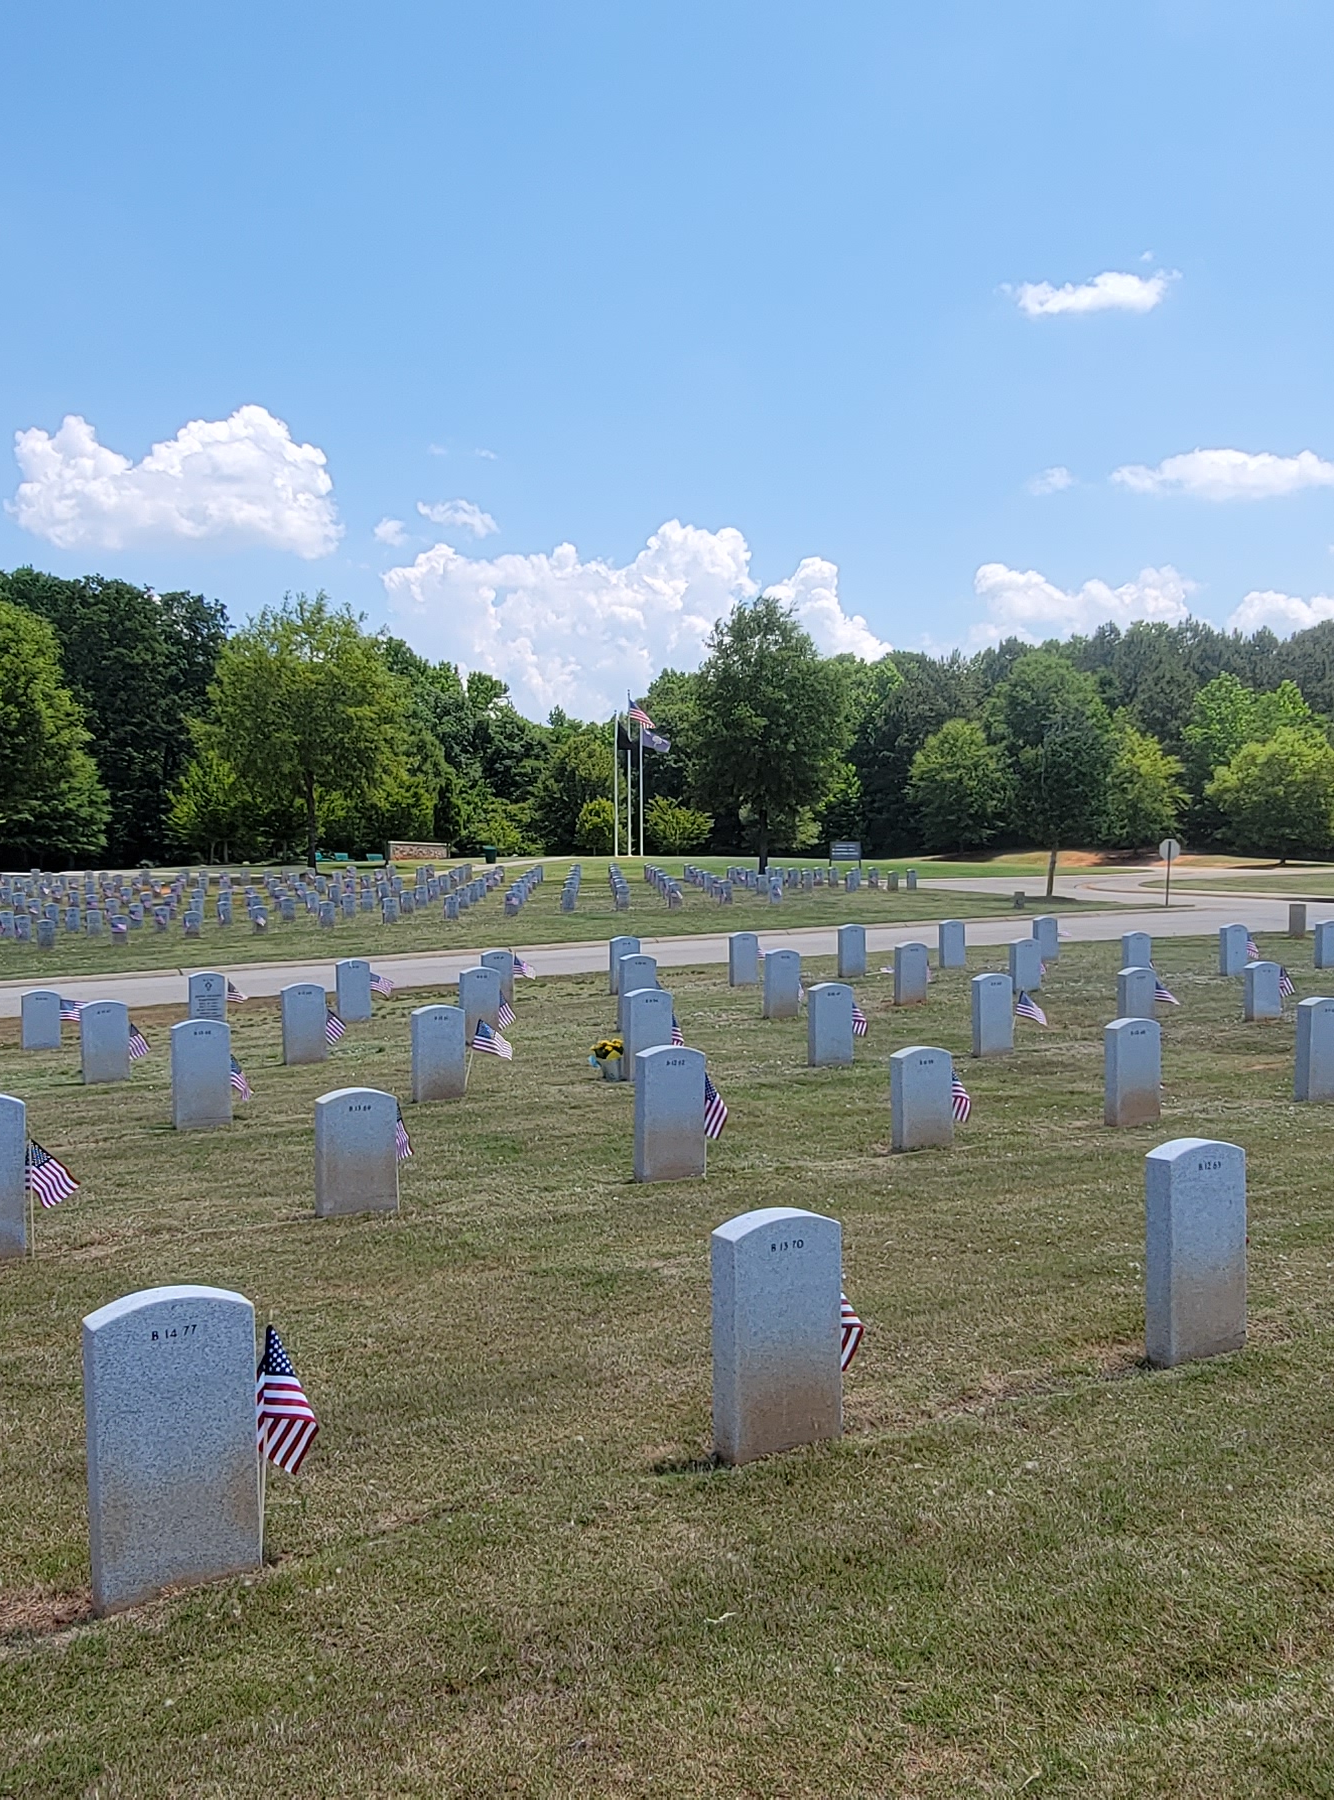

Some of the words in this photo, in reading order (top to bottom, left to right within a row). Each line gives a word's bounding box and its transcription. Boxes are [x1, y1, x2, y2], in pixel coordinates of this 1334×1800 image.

[771, 1243, 777, 1252] B
[780, 1241, 788, 1251] 13
[792, 1239, 804, 1249] 70
[151, 1330, 159, 1341] B
[165, 1328, 177, 1339] 14
[183, 1324, 197, 1336] 77
